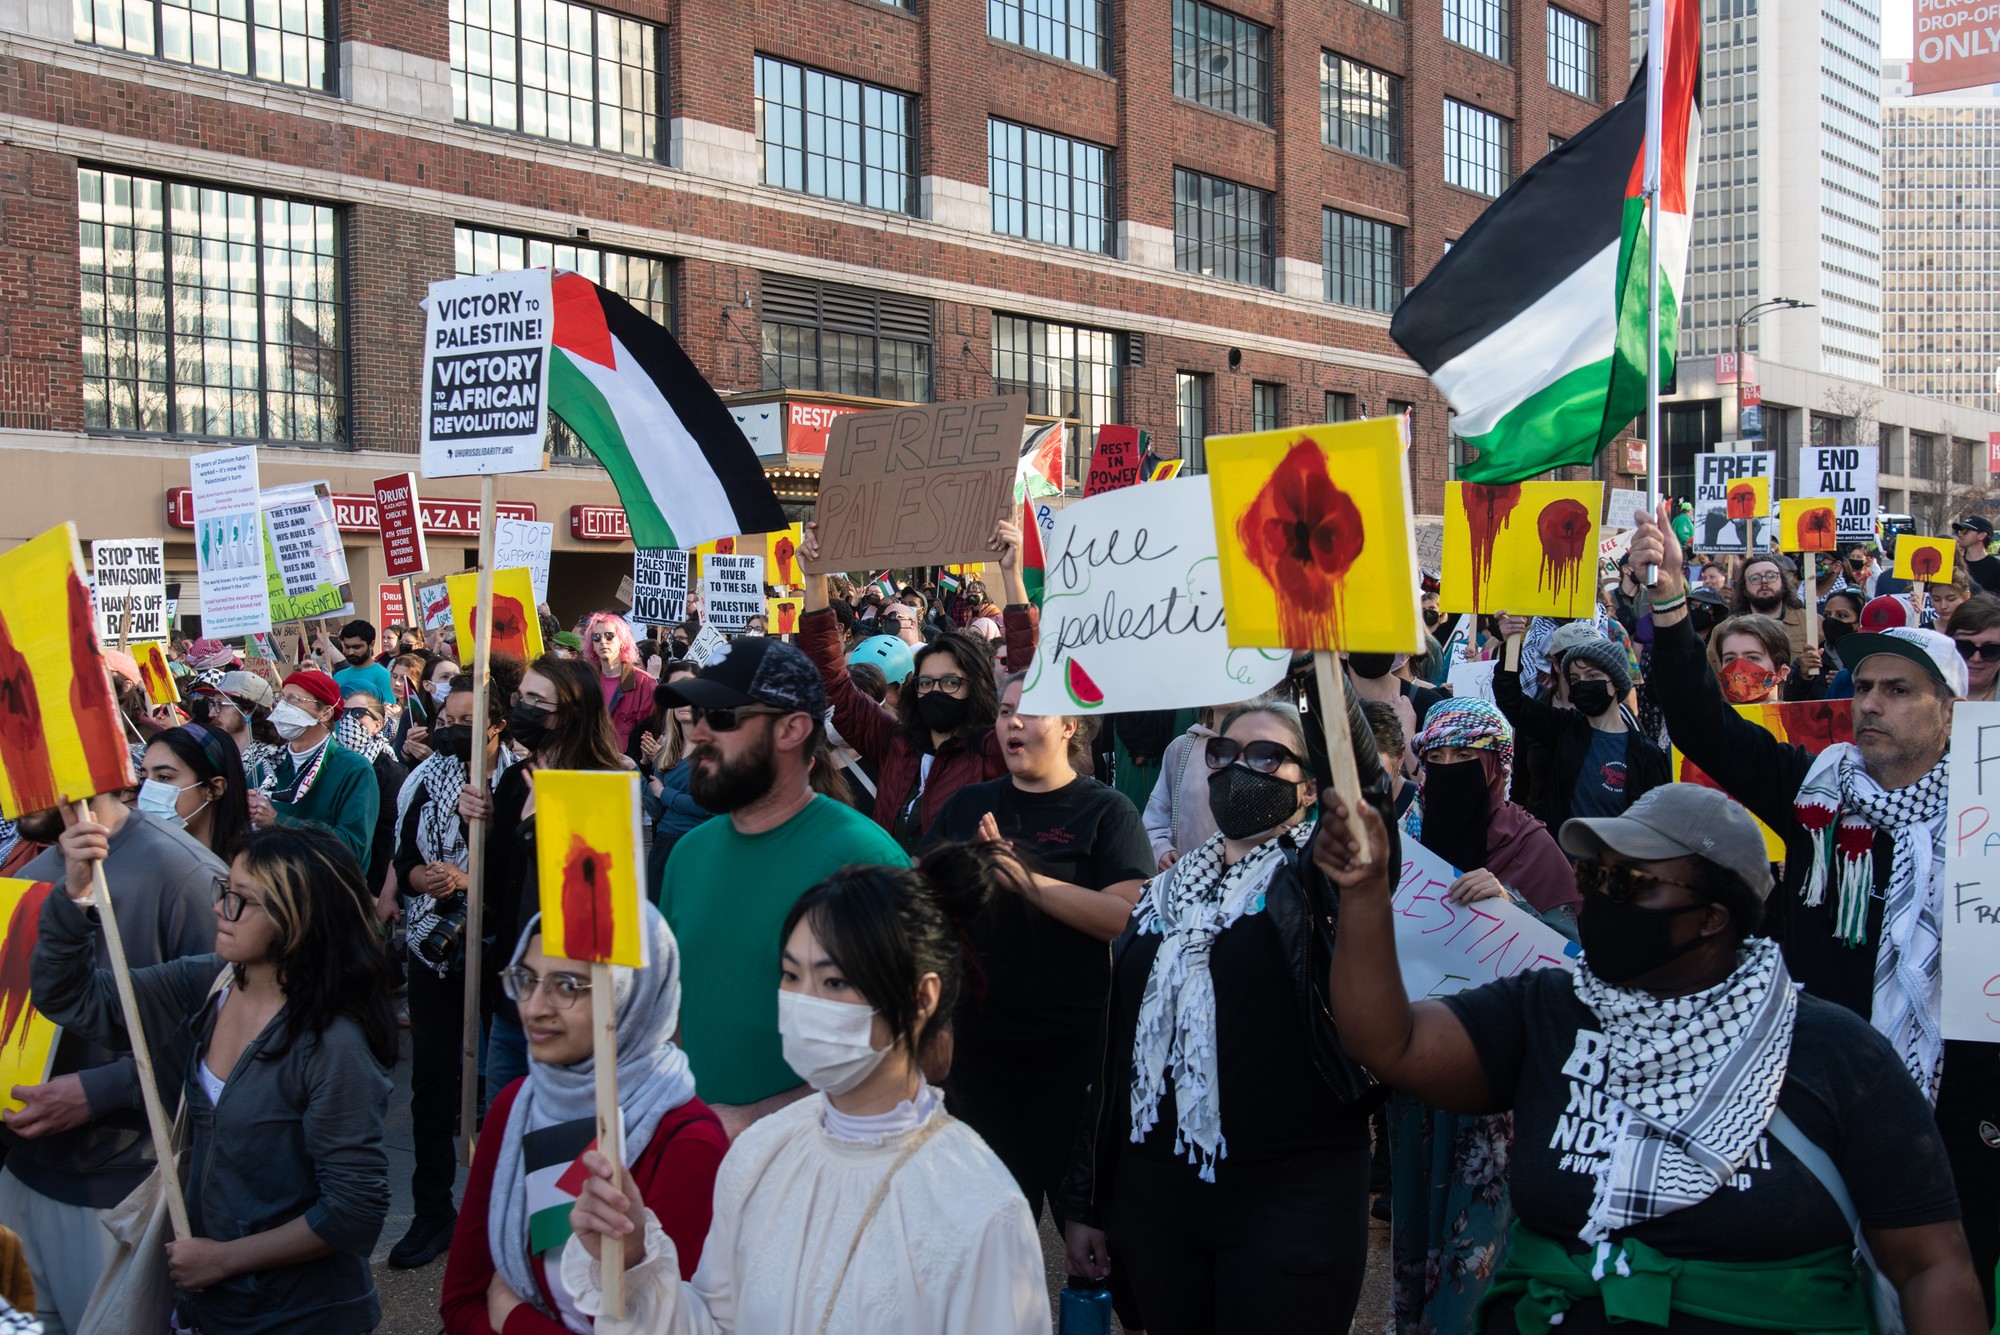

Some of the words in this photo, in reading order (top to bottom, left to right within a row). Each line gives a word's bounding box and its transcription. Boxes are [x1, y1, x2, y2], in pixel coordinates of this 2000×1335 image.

[1919, 5, 2000, 32] DROP-OF
[438, 290, 522, 321] VICTORY
[526, 299, 540, 312] TO
[436, 319, 542, 349] PALESTINE!
[436, 354, 538, 386] VICTORY
[433, 402, 448, 411] THE
[448, 384, 537, 412] AFRICAN
[436, 392, 446, 400] TO
[433, 411, 534, 434] REVOLUTION!
[840, 402, 1008, 477] FREE
[1101, 442, 1131, 455] REST
[1108, 456, 1123, 468] IN
[1818, 450, 1859, 470] END
[1820, 472, 1856, 492] ALL
[377, 486, 409, 504] DRURY
[286, 504, 311, 516] TYRANT
[1841, 498, 1870, 516] AID
[336, 505, 378, 525] RUR
[421, 508, 460, 528] AZA
[385, 512, 400, 520] CHECK
[274, 522, 289, 530] DIES
[291, 518, 305, 526] AND
[1836, 518, 1870, 530] RAEL!
[276, 533, 289, 542] HIS
[290, 529, 307, 539] RULE
[386, 530, 395, 538] 4TH
[396, 527, 413, 536] STREET
[502, 521, 550, 545] STOP
[300, 540, 313, 550] THE
[391, 538, 409, 547] BEFORE
[98, 547, 132, 565] STOP
[135, 547, 159, 565] THE
[281, 550, 310, 561] MARTYR
[390, 546, 414, 557] ENTERING
[637, 550, 664, 559] STAND
[666, 550, 687, 562] WITH
[1047, 525, 1178, 589] free
[284, 564, 300, 573] DIES
[301, 561, 315, 570] AND
[393, 556, 413, 565] GARAGE
[637, 558, 686, 573] PALESTINE!
[712, 556, 736, 567] FROM
[739, 558, 755, 568] THE
[98, 568, 162, 586] INVASION!
[286, 576, 299, 584] HIS
[300, 573, 317, 582] RULE
[636, 569, 660, 586] END
[664, 572, 686, 589] THE
[720, 570, 746, 580] RIVER
[635, 585, 685, 600] OCCUPATION
[710, 582, 721, 592] TO
[723, 582, 739, 592] THE
[741, 583, 757, 594] SEA
[144, 596, 162, 610] OFF
[635, 596, 683, 621] NOW!
[711, 601, 760, 612] PALESTINE
[709, 614, 728, 623] WILL
[730, 615, 740, 624] BE
